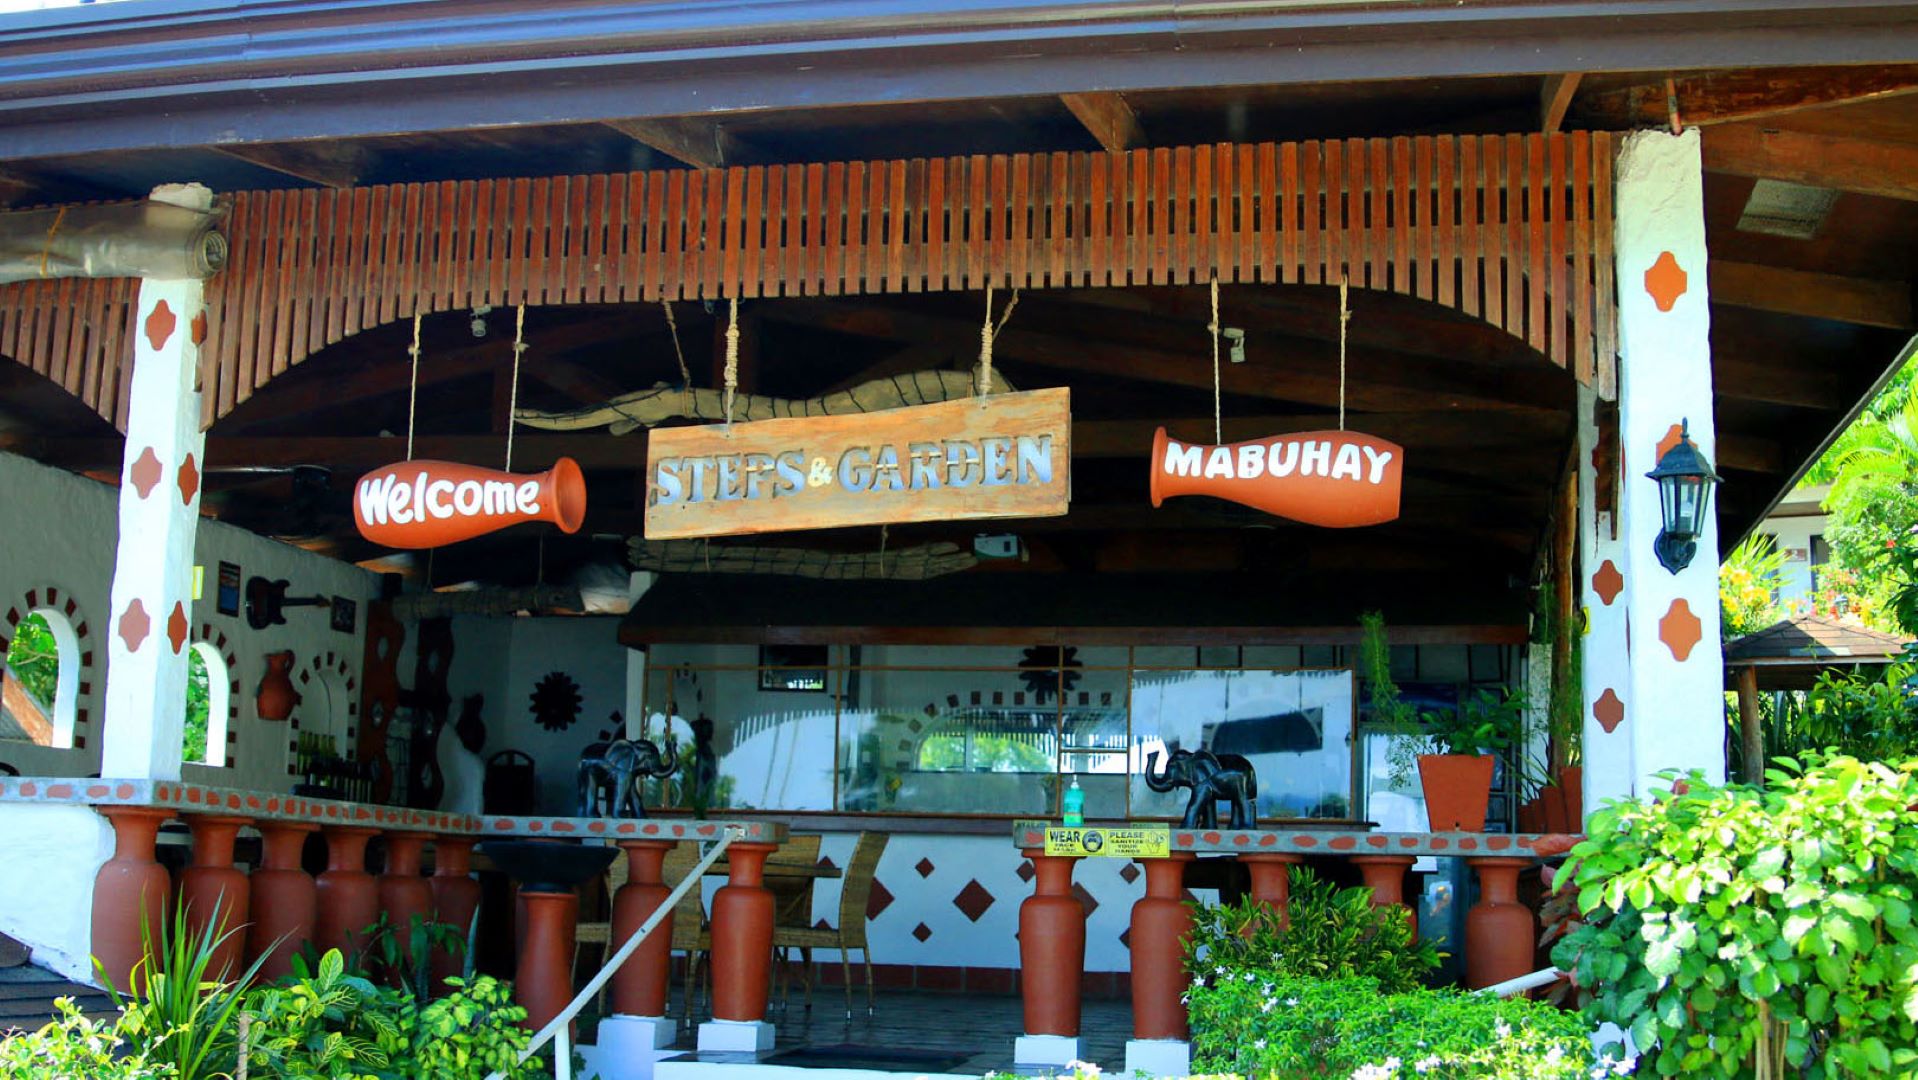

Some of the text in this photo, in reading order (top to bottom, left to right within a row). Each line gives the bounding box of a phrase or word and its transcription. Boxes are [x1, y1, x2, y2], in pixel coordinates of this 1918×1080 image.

[649, 433, 1053, 506] STEPS & GARDEN
[1164, 440, 1392, 485] MABUHAY
[360, 471, 541, 526] Welcome
[1049, 830, 1080, 843] WEAR
[1109, 831, 1145, 839] PLEASE
